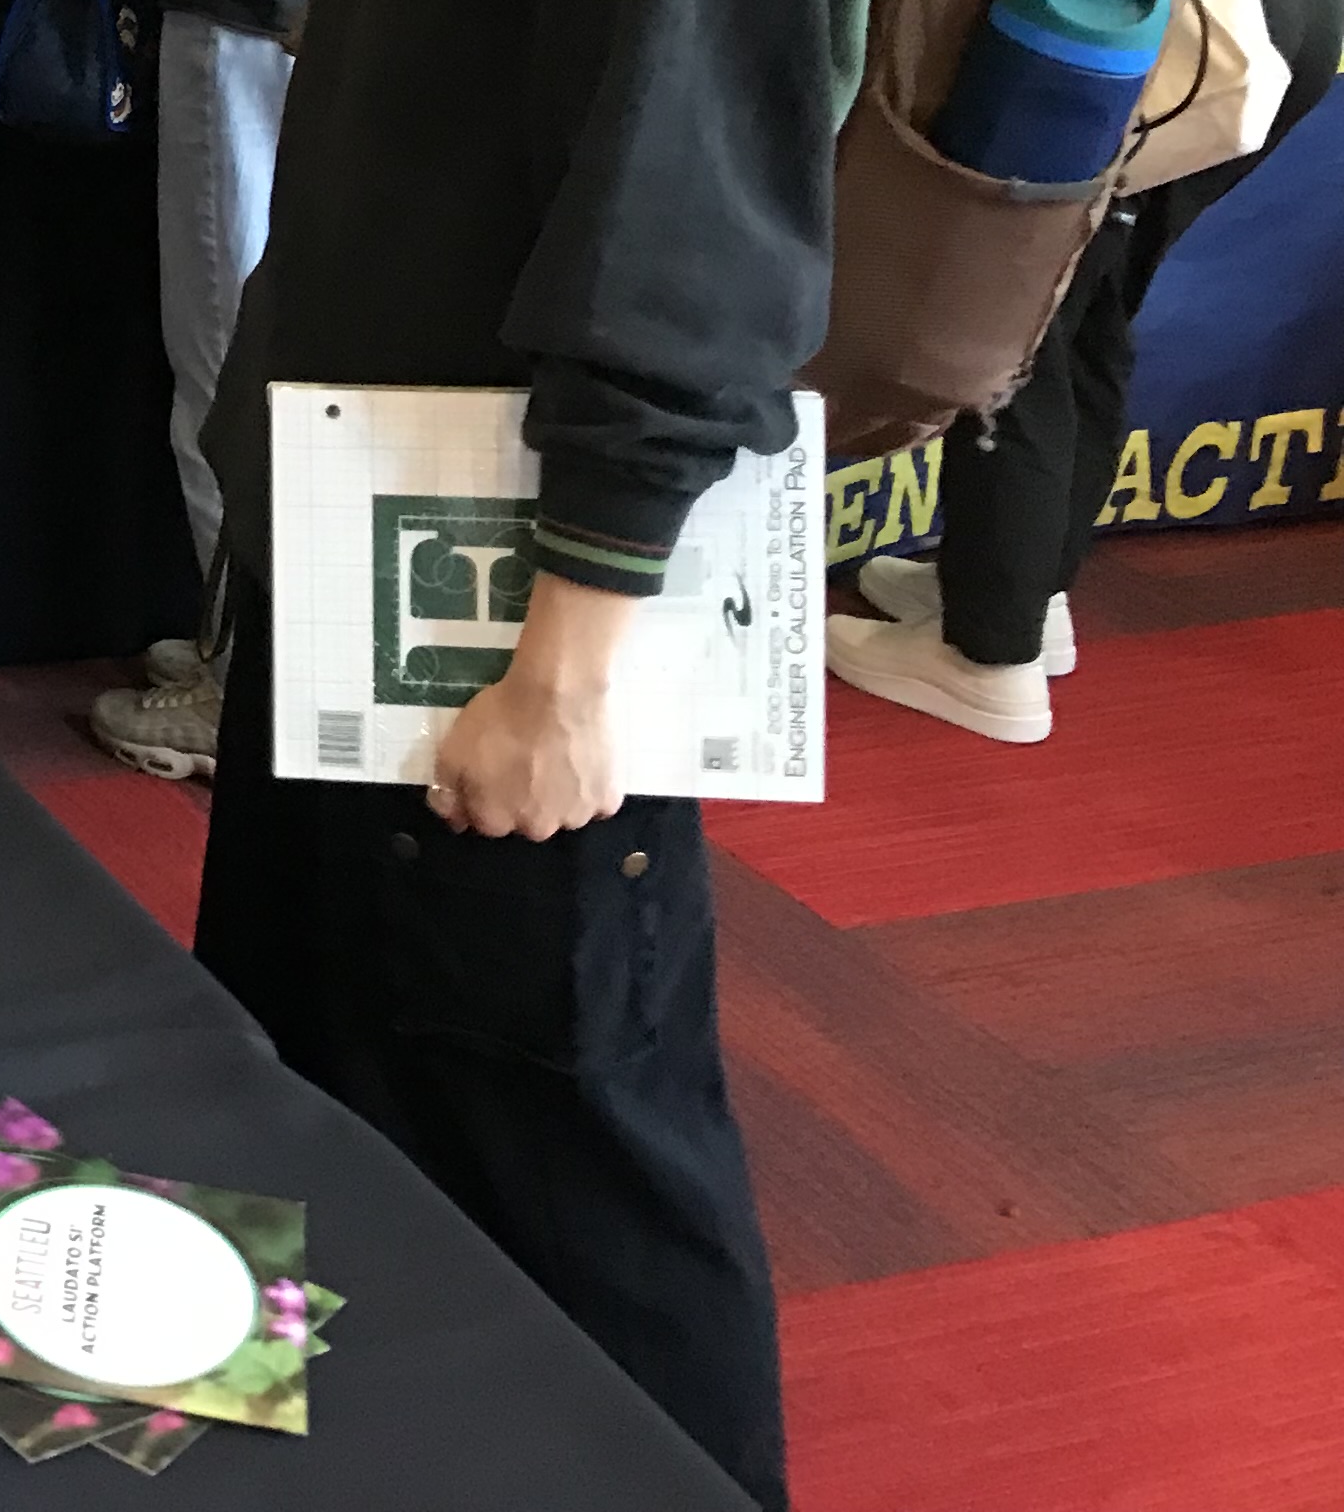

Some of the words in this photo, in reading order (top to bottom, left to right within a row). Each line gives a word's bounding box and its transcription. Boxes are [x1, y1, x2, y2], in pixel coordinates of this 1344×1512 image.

[784, 447, 807, 491] PAD
[784, 502, 808, 654] CALCULATION
[784, 664, 807, 778] ENGINEER
[62, 1246, 82, 1323] LAUDATO
[85, 1203, 107, 1287] PLATFORM
[81, 1292, 100, 1355] ACTION
